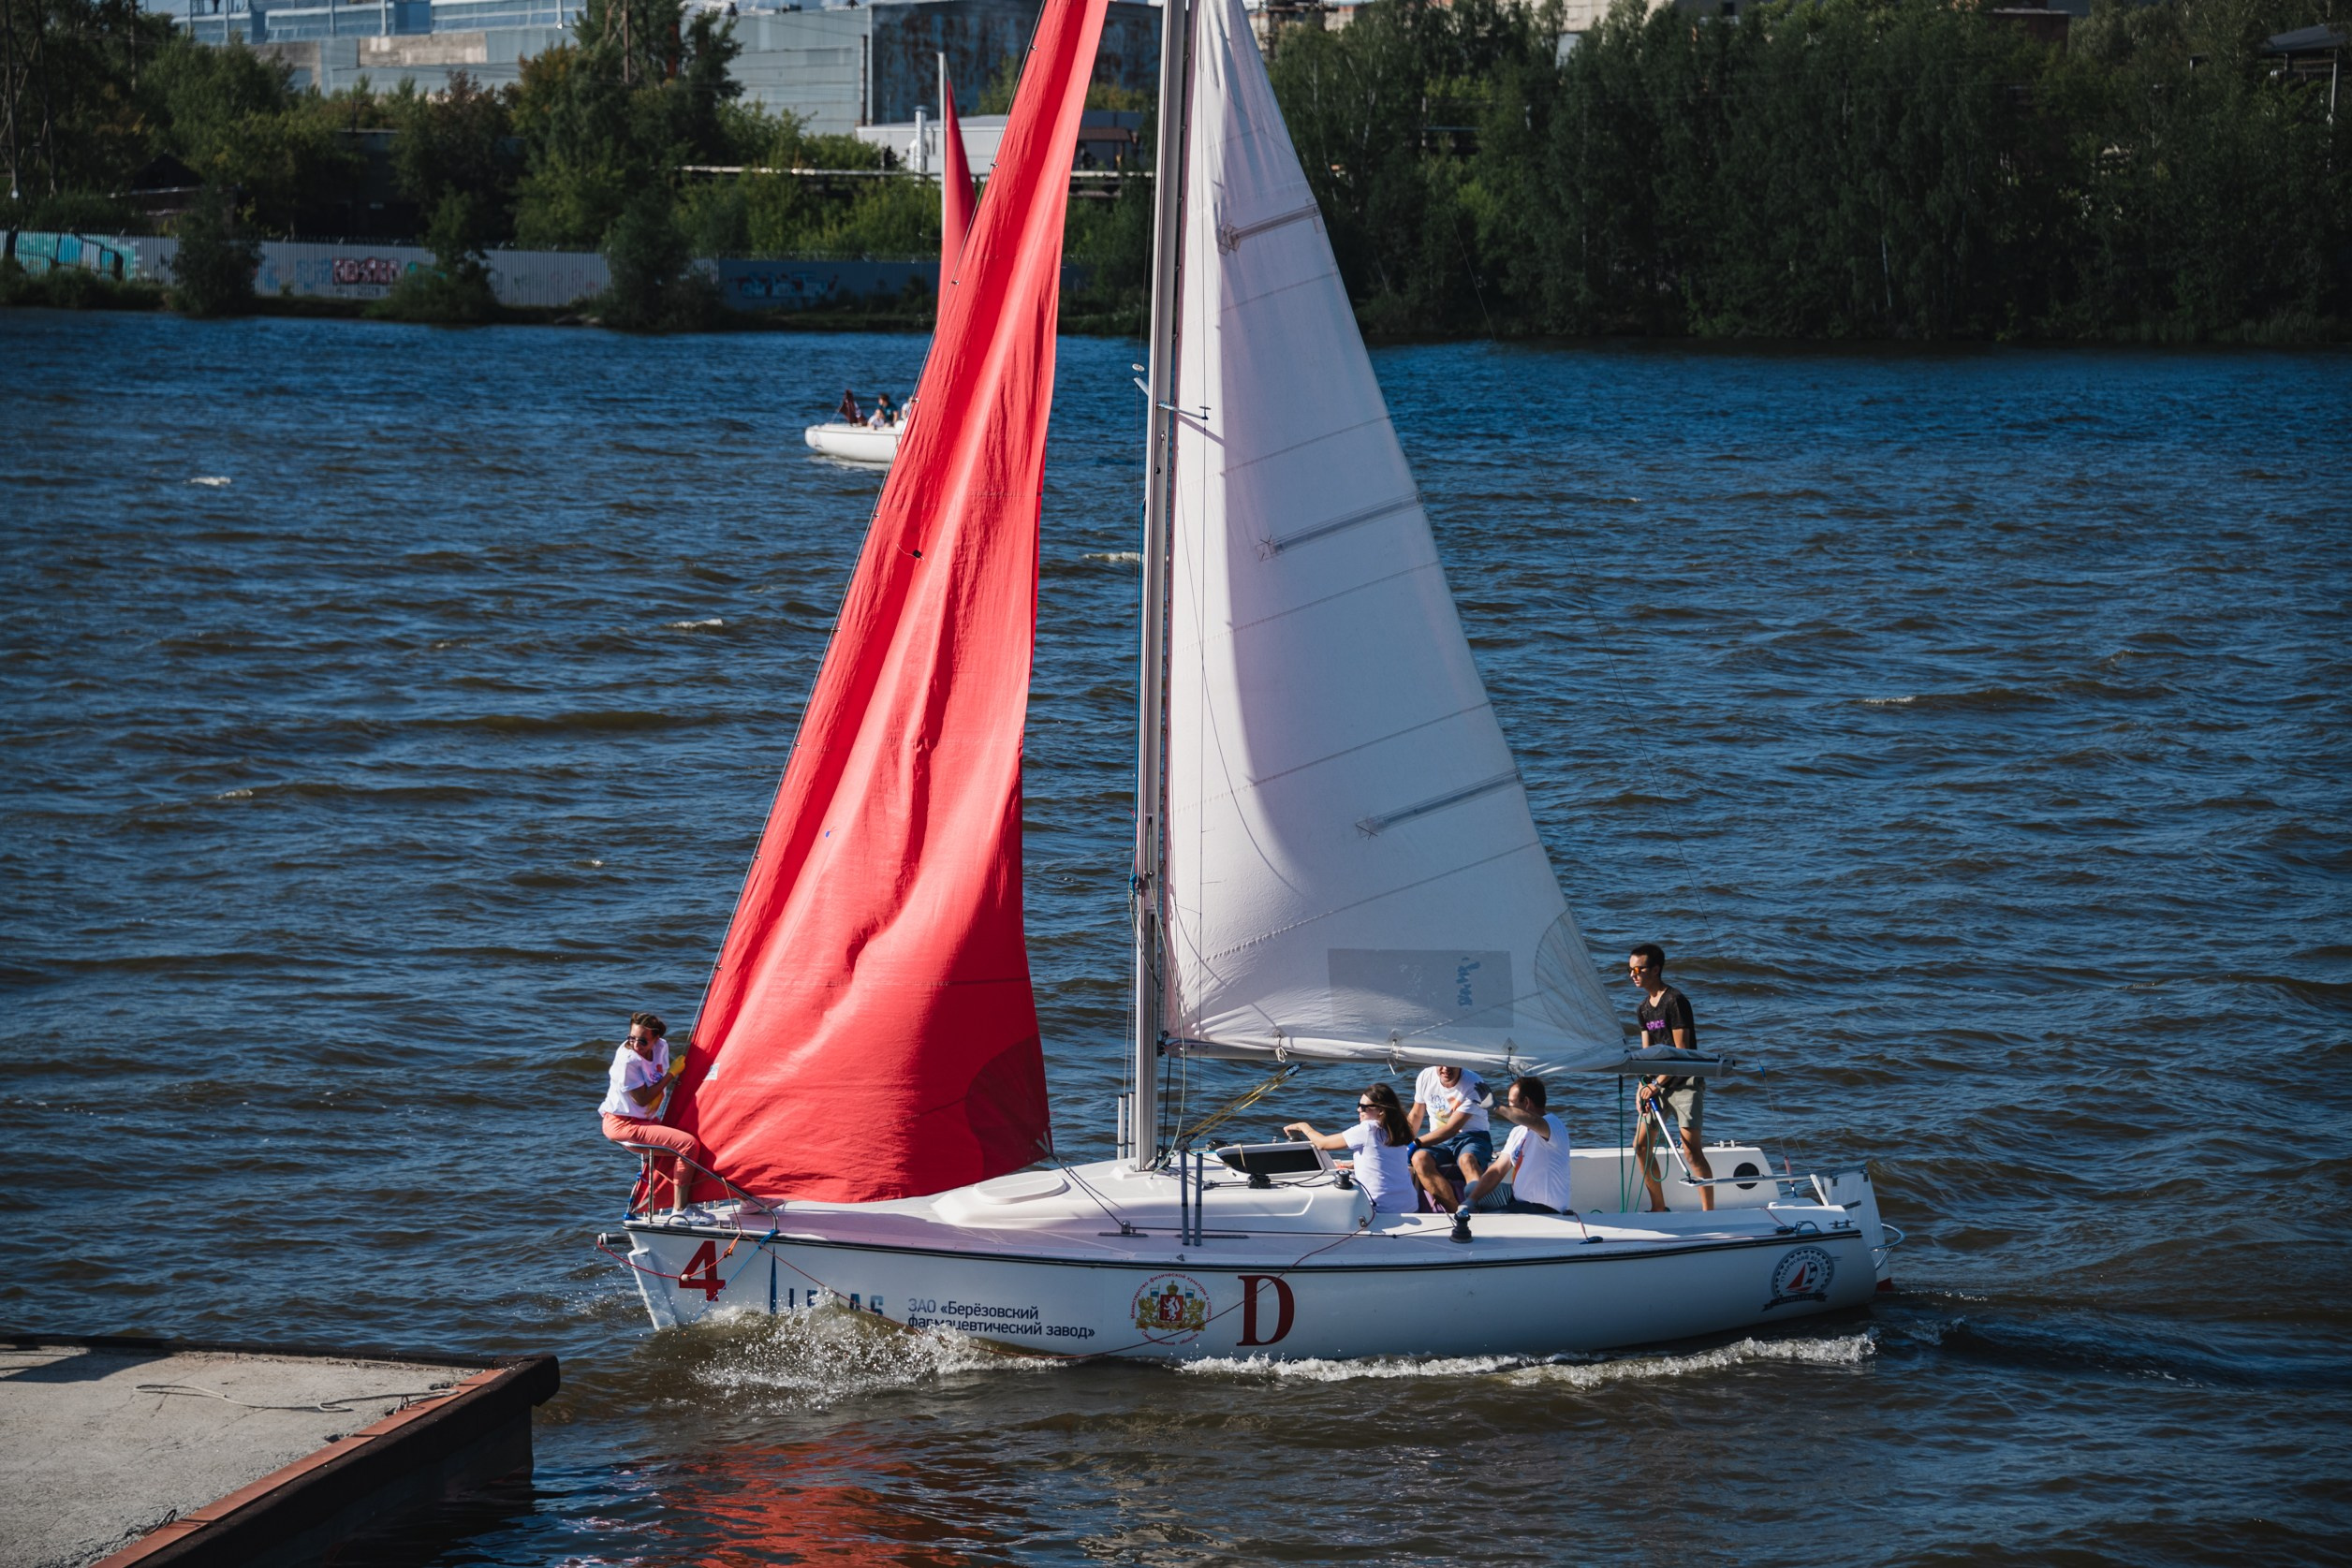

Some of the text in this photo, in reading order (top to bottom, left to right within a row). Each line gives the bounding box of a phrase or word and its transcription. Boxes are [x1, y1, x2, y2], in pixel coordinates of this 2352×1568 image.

[679, 1240, 726, 1302] 4
[1149, 1272, 1186, 1283] физической
[1186, 1277, 1208, 1297] культуры
[908, 1297, 1039, 1320] ЗАО «Берёзовский
[1236, 1275, 1295, 1347] D
[1046, 1324, 1095, 1340] завод»
